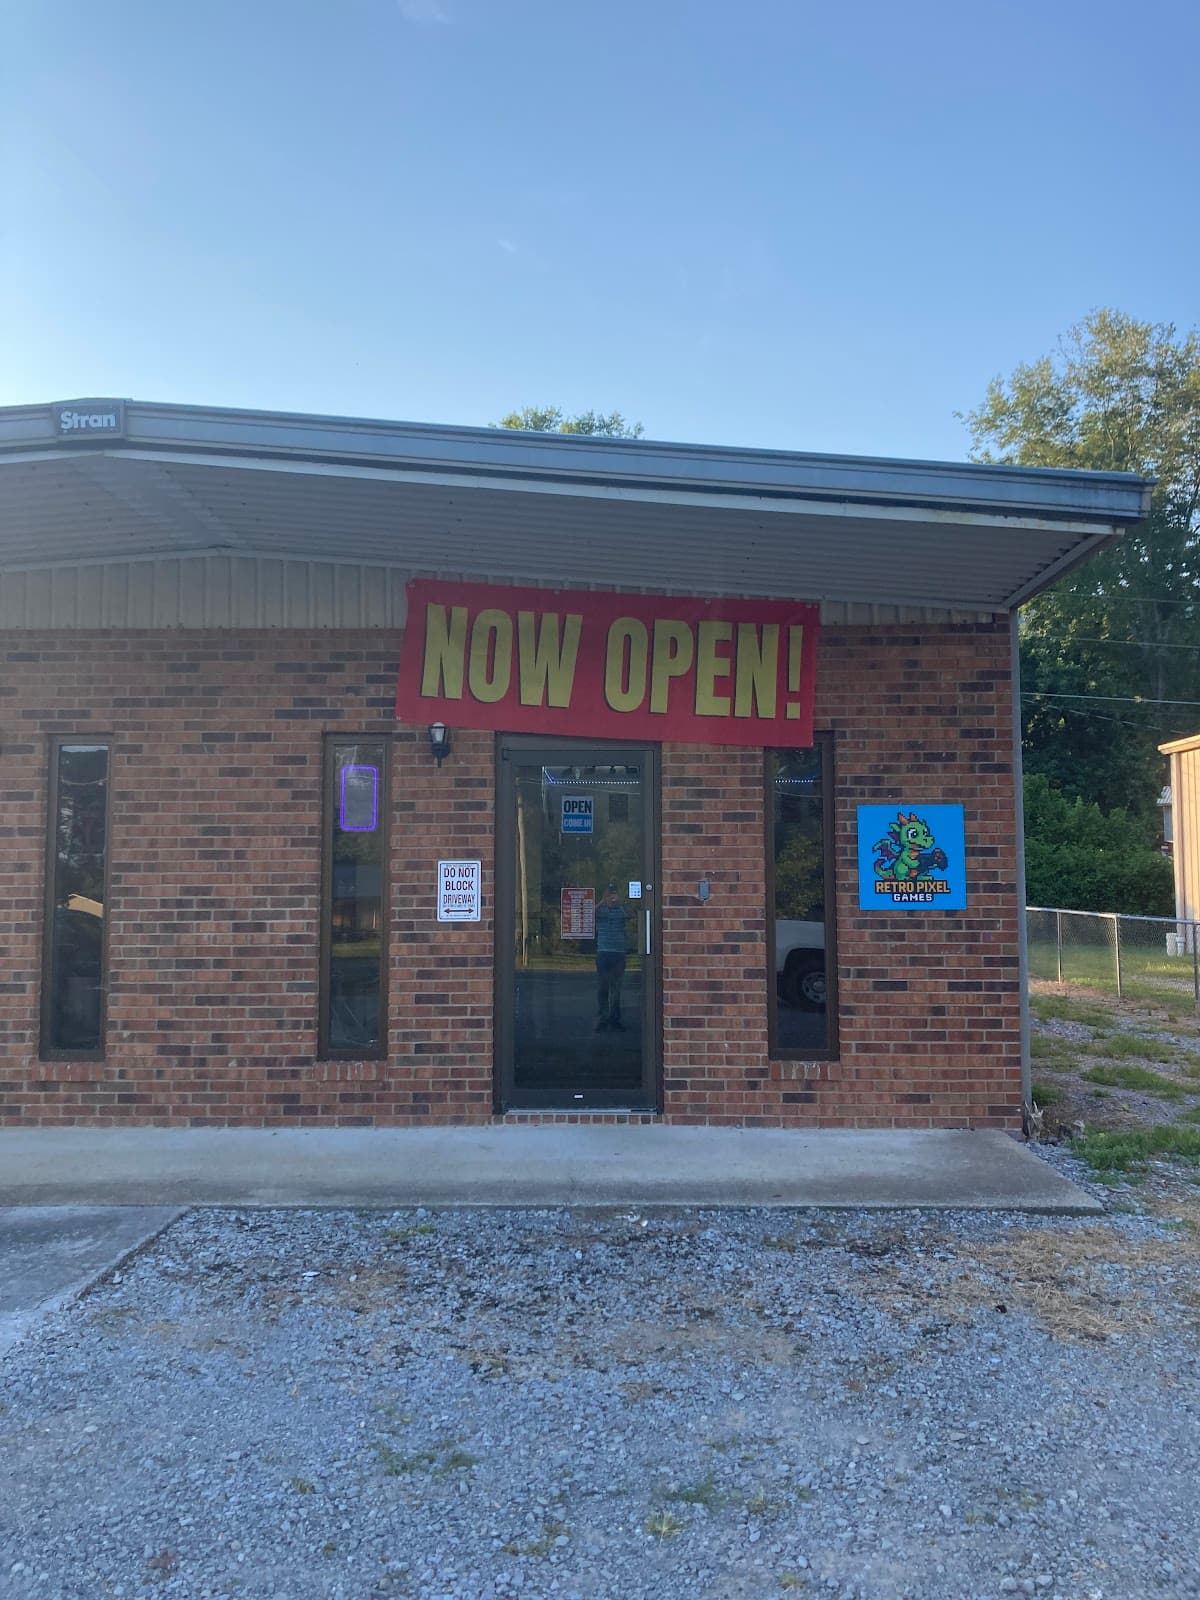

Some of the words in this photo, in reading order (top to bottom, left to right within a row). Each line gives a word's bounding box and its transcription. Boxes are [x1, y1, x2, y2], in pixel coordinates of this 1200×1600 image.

[60, 411, 116, 429] Stran
[421, 602, 583, 708] NOW
[604, 616, 804, 719] OPEN!
[563, 800, 592, 813] OPEN
[443, 867, 456, 878] DO
[458, 867, 476, 878] NOT
[445, 880, 474, 891] BLOCK
[875, 881, 915, 893] RETRO
[916, 881, 950, 893] PIXEL
[443, 894, 476, 904] DRIVEWAY
[893, 893, 933, 902] GAMES
